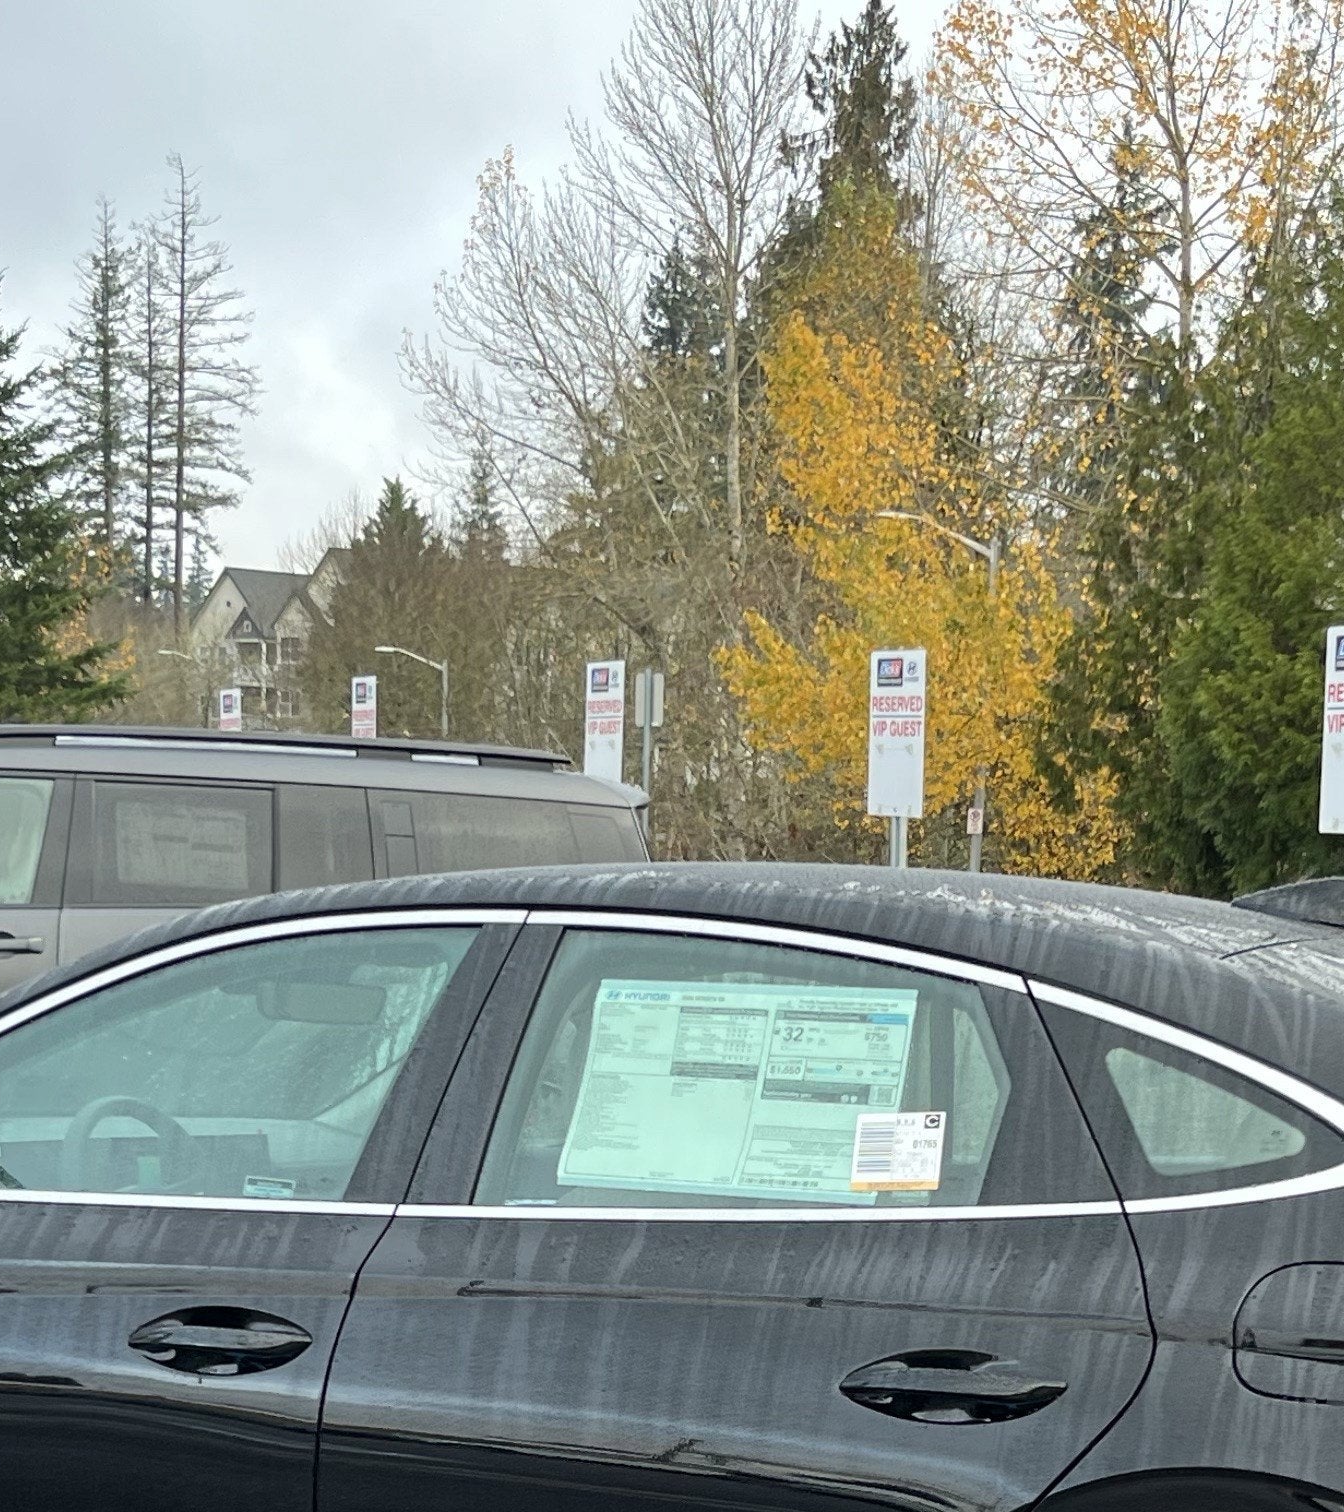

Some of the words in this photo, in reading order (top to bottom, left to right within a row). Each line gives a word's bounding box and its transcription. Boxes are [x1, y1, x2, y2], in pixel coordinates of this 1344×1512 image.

[872, 696, 922, 712] RESERVED
[872, 720, 887, 737] VIP
[890, 720, 921, 737] GUEST
[783, 1026, 805, 1042] 32
